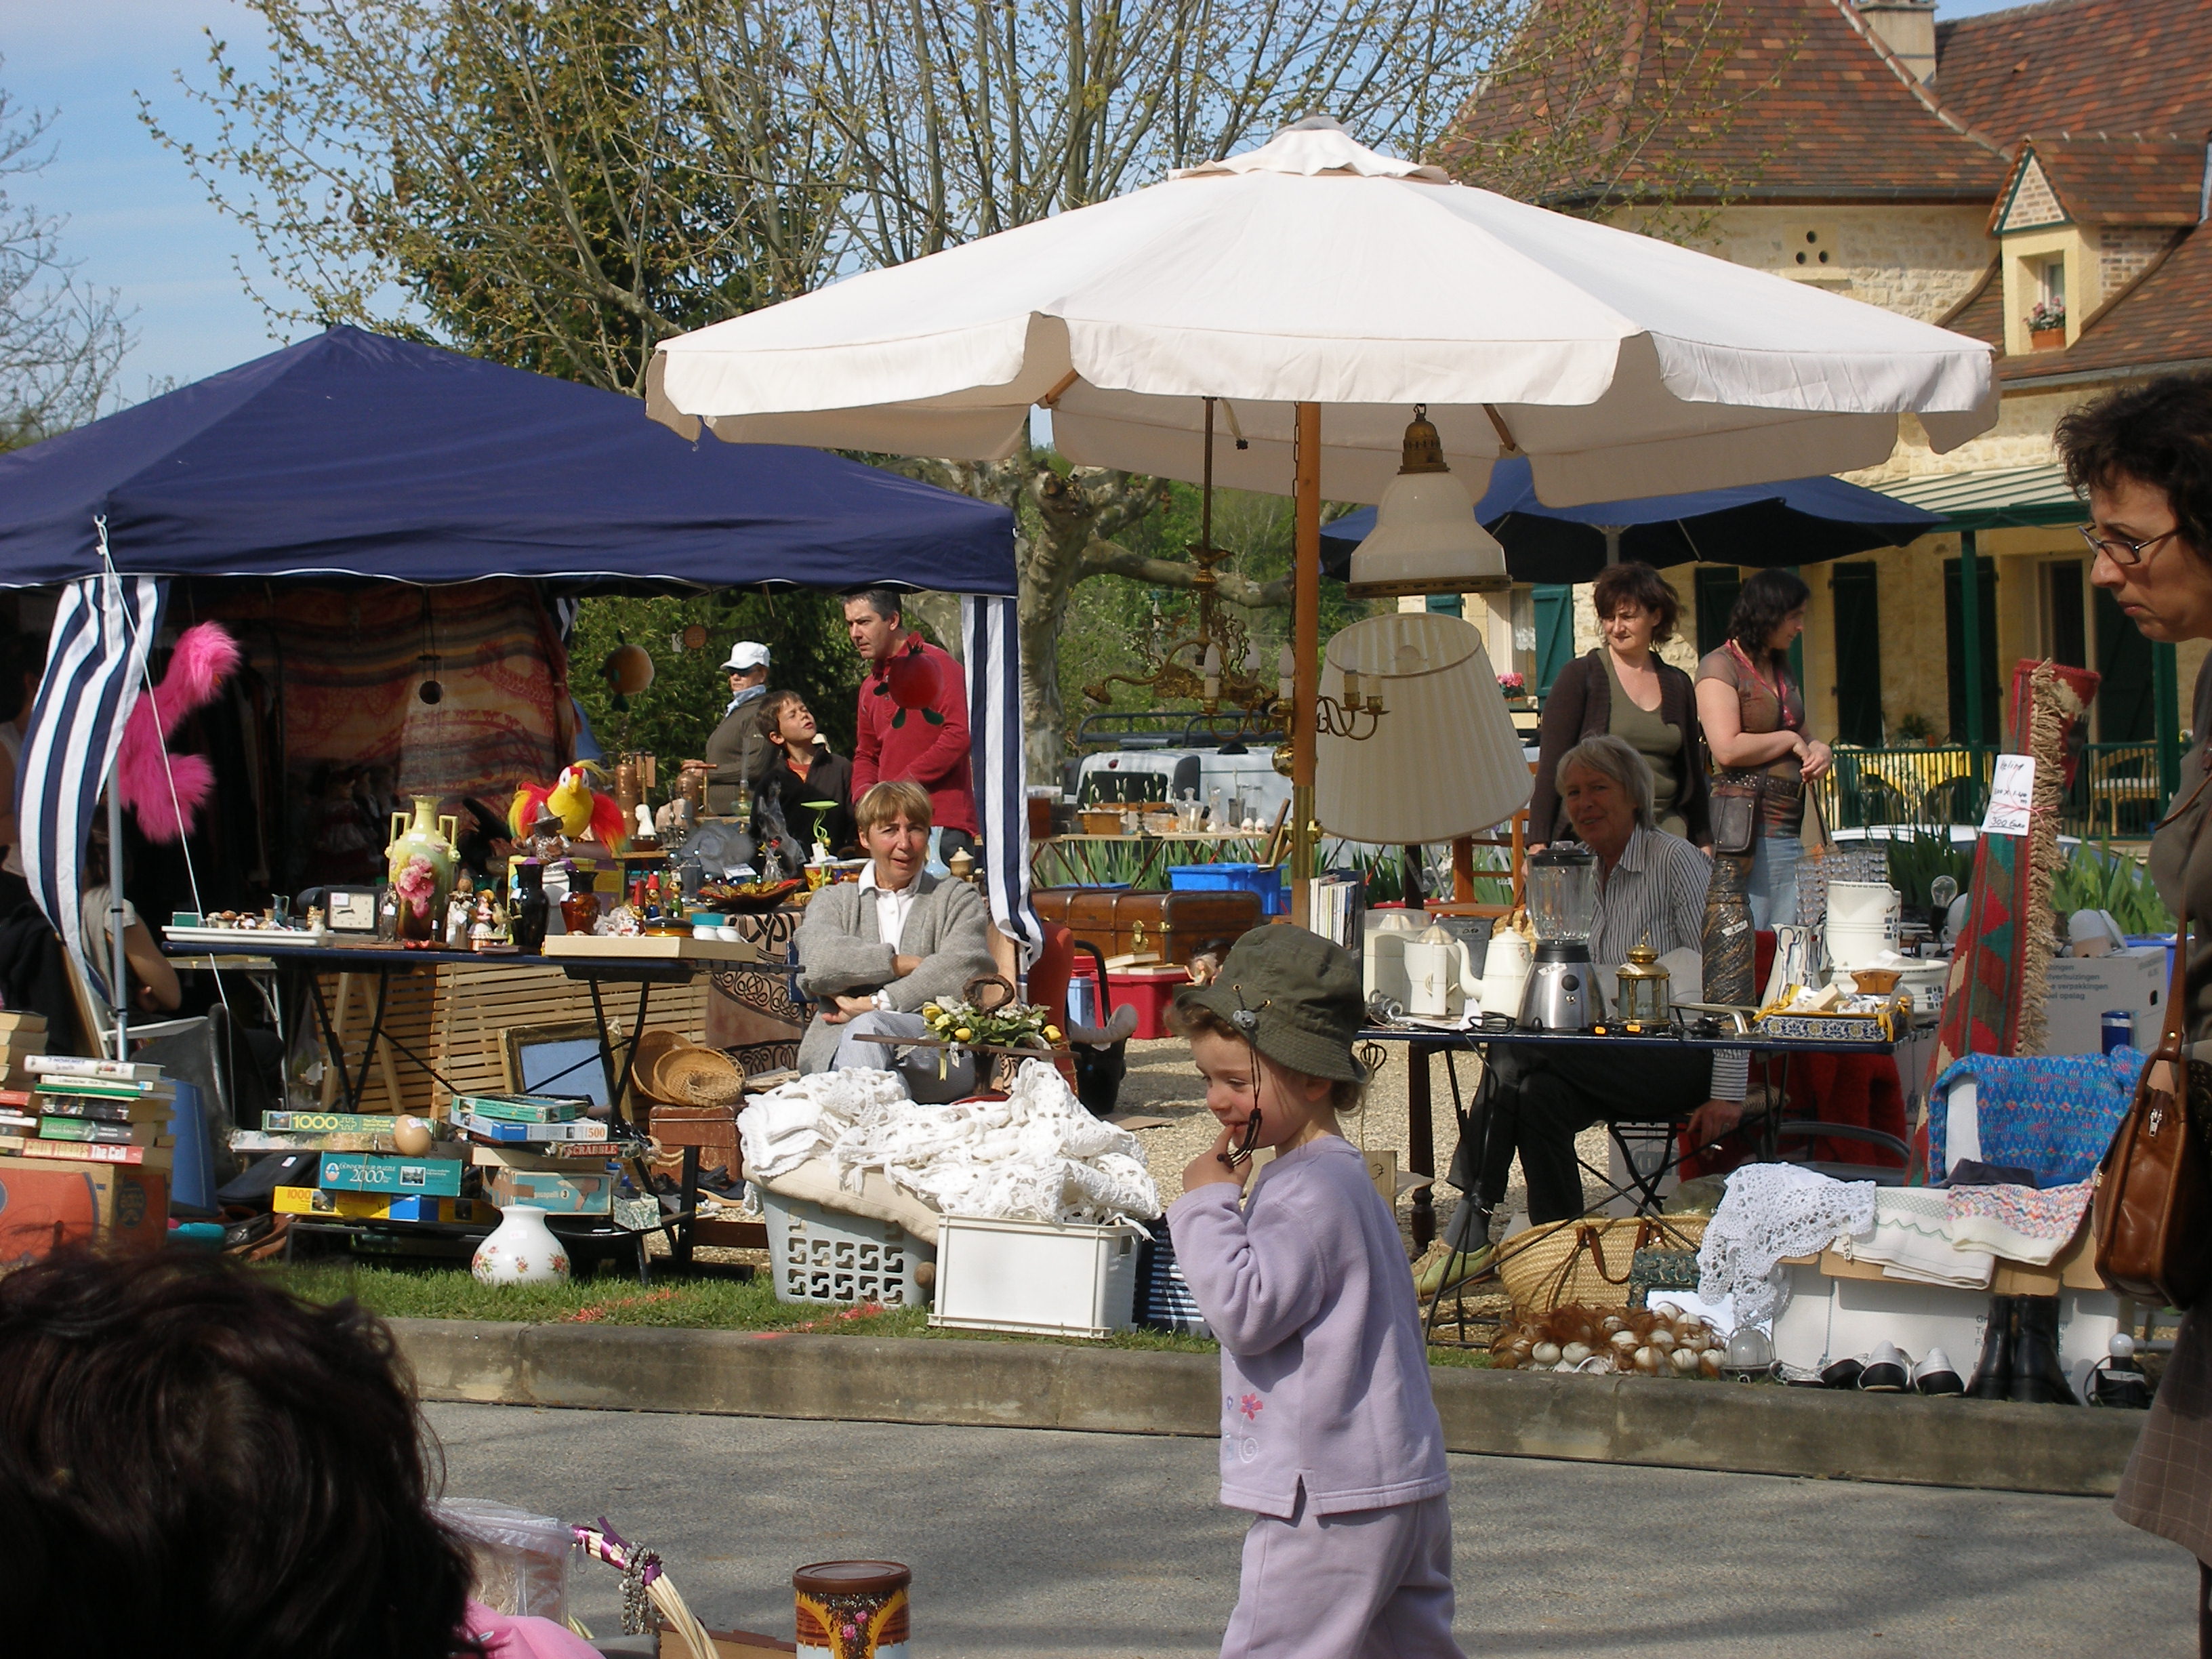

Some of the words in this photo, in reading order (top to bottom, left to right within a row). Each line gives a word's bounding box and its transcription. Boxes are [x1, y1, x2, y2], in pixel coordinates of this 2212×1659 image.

[1991, 817, 2007, 827] 300
[2009, 819, 2025, 828] Euro
[292, 1115, 338, 1130] 1000
[588, 1128, 605, 1138] 500
[25, 1141, 52, 1156] COLIN
[54, 1143, 89, 1159] FORBES
[91, 1145, 107, 1160] The
[108, 1147, 127, 1160] Cell
[567, 1145, 617, 1156] SCRABBLE
[349, 1168, 384, 1183] 2000
[287, 1189, 312, 1200] 1000
